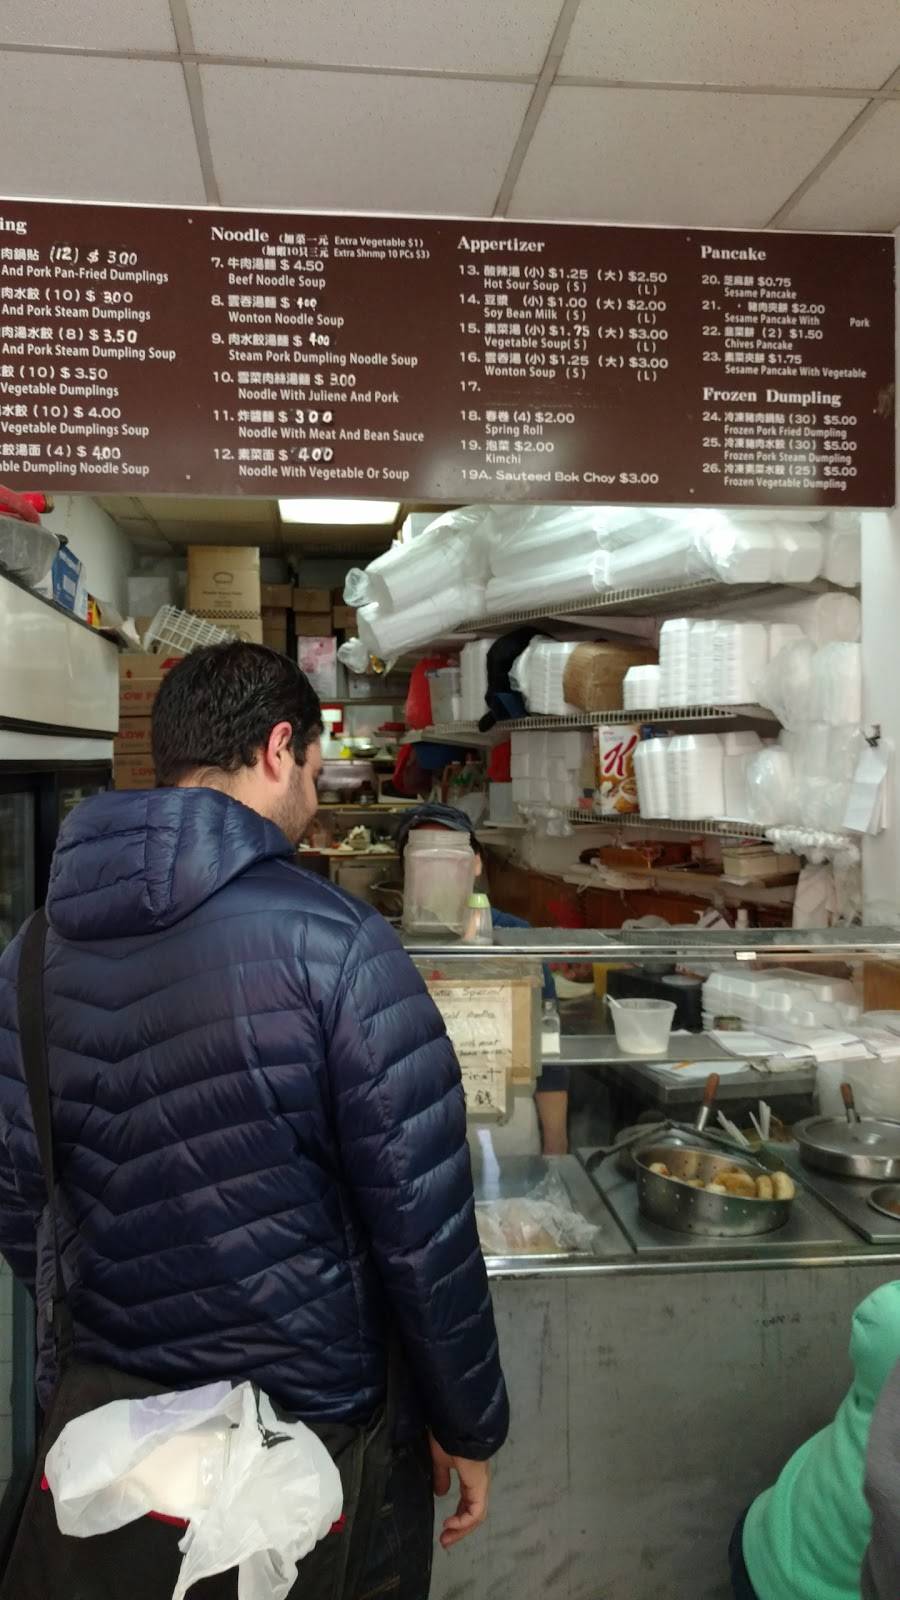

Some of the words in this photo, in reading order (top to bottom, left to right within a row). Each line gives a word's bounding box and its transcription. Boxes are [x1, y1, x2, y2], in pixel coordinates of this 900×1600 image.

[211, 227, 269, 242] Noodle
[335, 236, 358, 245] Extra
[360, 237, 405, 249] Vegetable
[457, 236, 545, 253] Appertizer
[50, 246, 78, 264] (12)
[334, 248, 355, 257] Extra
[388, 249, 398, 258] 10
[701, 246, 766, 260] Pancake
[211, 257, 224, 268] 7.
[294, 260, 324, 272] 4.50
[2, 265, 23, 276] And
[27, 265, 51, 277] Pork
[55, 267, 107, 279] Pan-Fried
[110, 269, 168, 284] Dumplings
[229, 273, 253, 285] Beef
[256, 274, 295, 286] Noodle
[299, 275, 326, 289] Soup
[459, 265, 479, 275] 13.
[549, 267, 588, 279] $1.25
[628, 271, 667, 283] $2.50
[702, 275, 720, 285] 20.
[757, 276, 791, 287] $0.75
[484, 278, 502, 289] Hot
[506, 279, 530, 290] Sour
[533, 279, 559, 293] Soup
[725, 287, 758, 298] Sesame
[760, 288, 797, 299] Pancake
[211, 295, 224, 306] 8.
[460, 294, 480, 304] 14.
[547, 296, 587, 308] $1.00
[627, 299, 666, 311] $2.00
[702, 300, 720, 310] 21.
[792, 303, 825, 314] $2.00
[2, 304, 23, 315] And
[27, 305, 52, 316] Pork
[55, 305, 89, 317] Steam
[92, 307, 150, 322] Dumplings
[229, 311, 271, 323] Wonton
[275, 313, 314, 325] Noodle
[317, 314, 344, 328] Soup
[484, 307, 503, 320] Soy
[506, 308, 532, 318] Bean
[535, 309, 557, 319] Milk
[725, 312, 758, 323] Sesame
[761, 314, 797, 325] Pancake
[799, 316, 820, 325] With
[850, 317, 870, 327] Pork
[212, 333, 224, 344] 9.
[460, 323, 480, 333] 15.
[629, 328, 668, 340] $3.00
[703, 326, 721, 335] 22.
[790, 328, 823, 339] $1.50
[484, 336, 537, 349] Vegetable
[725, 338, 754, 349] Chives
[756, 339, 793, 350] Pancake
[2, 343, 24, 354] And
[28, 344, 53, 355] Pork
[55, 344, 89, 356] Steam
[92, 346, 145, 361] Dumpling
[149, 347, 176, 361] Soup
[229, 349, 263, 361] Steam
[266, 350, 290, 362] Pork
[294, 351, 346, 366] Dumpling
[350, 353, 388, 365] Noodle
[391, 354, 418, 367] Soup
[703, 351, 721, 361] 23.
[768, 353, 802, 364] $1.75
[460, 352, 480, 362] 16.
[550, 354, 589, 366] $1.25
[629, 357, 668, 368] $3.00
[213, 371, 234, 383] 10.
[485, 365, 526, 376] Wonton
[529, 366, 555, 379] Soup
[725, 364, 759, 375] Sesame
[761, 365, 797, 376] Pancake
[799, 367, 820, 376] With
[822, 367, 866, 379] Vegetable
[0, 382, 56, 396] Vegetable
[60, 383, 119, 399] Dumplings
[461, 381, 480, 391] 17.
[238, 388, 277, 400] Noodle
[280, 389, 305, 400] With
[308, 390, 347, 402] Juliene
[350, 391, 371, 402] And
[375, 391, 398, 403] Pork
[704, 387, 757, 402] Frozen
[767, 389, 841, 407] Dumpling
[88, 407, 121, 418] 4.00
[214, 410, 234, 421] 11.
[461, 410, 481, 421] 18.
[535, 412, 575, 423] $2.00
[703, 411, 721, 421] 24.
[824, 415, 857, 425] $5.00
[1, 421, 57, 435] Vegetable
[60, 422, 119, 438] Dumplings
[121, 424, 149, 438] Soup
[239, 426, 278, 438] Noodle
[280, 427, 306, 439] With
[309, 428, 336, 440] Meat
[339, 429, 360, 440] And
[364, 430, 390, 440] Bean
[393, 430, 424, 441] Sauce
[485, 424, 519, 437] Spring
[523, 424, 543, 435] Roll
[724, 424, 754, 435] Frozen
[757, 425, 777, 435] Pork
[779, 426, 801, 436] Fried
[804, 427, 847, 440] Dumpling
[461, 440, 481, 450] 19.
[514, 440, 554, 452] $2.00
[702, 437, 721, 447] 25.
[824, 440, 857, 451] $5.00
[214, 448, 234, 460] 12.
[486, 453, 521, 464] Kimchi
[724, 450, 754, 460] Frozen
[757, 451, 776, 461] Pork
[779, 452, 806, 462] Steam
[809, 453, 851, 465] Dumpling
[23, 461, 77, 476] Dumpling
[80, 462, 119, 474] Noodle
[122, 463, 149, 477] Soup
[239, 465, 278, 477] Noodle
[281, 466, 306, 477] With
[309, 466, 364, 480] Vegetable
[367, 468, 379, 479] Or
[383, 468, 409, 481] Soup
[462, 469, 492, 480] 19A.
[496, 470, 551, 482] Sauteed
[555, 472, 579, 482] Bok
[583, 472, 615, 484] Choy
[619, 473, 659, 484] $3.00
[703, 463, 721, 473] 26.
[824, 466, 857, 476] $5.00
[724, 476, 754, 486] Frozen
[756, 477, 801, 489] Vegetable
[804, 479, 847, 491] Dumpling
[604, 735, 637, 776] K
